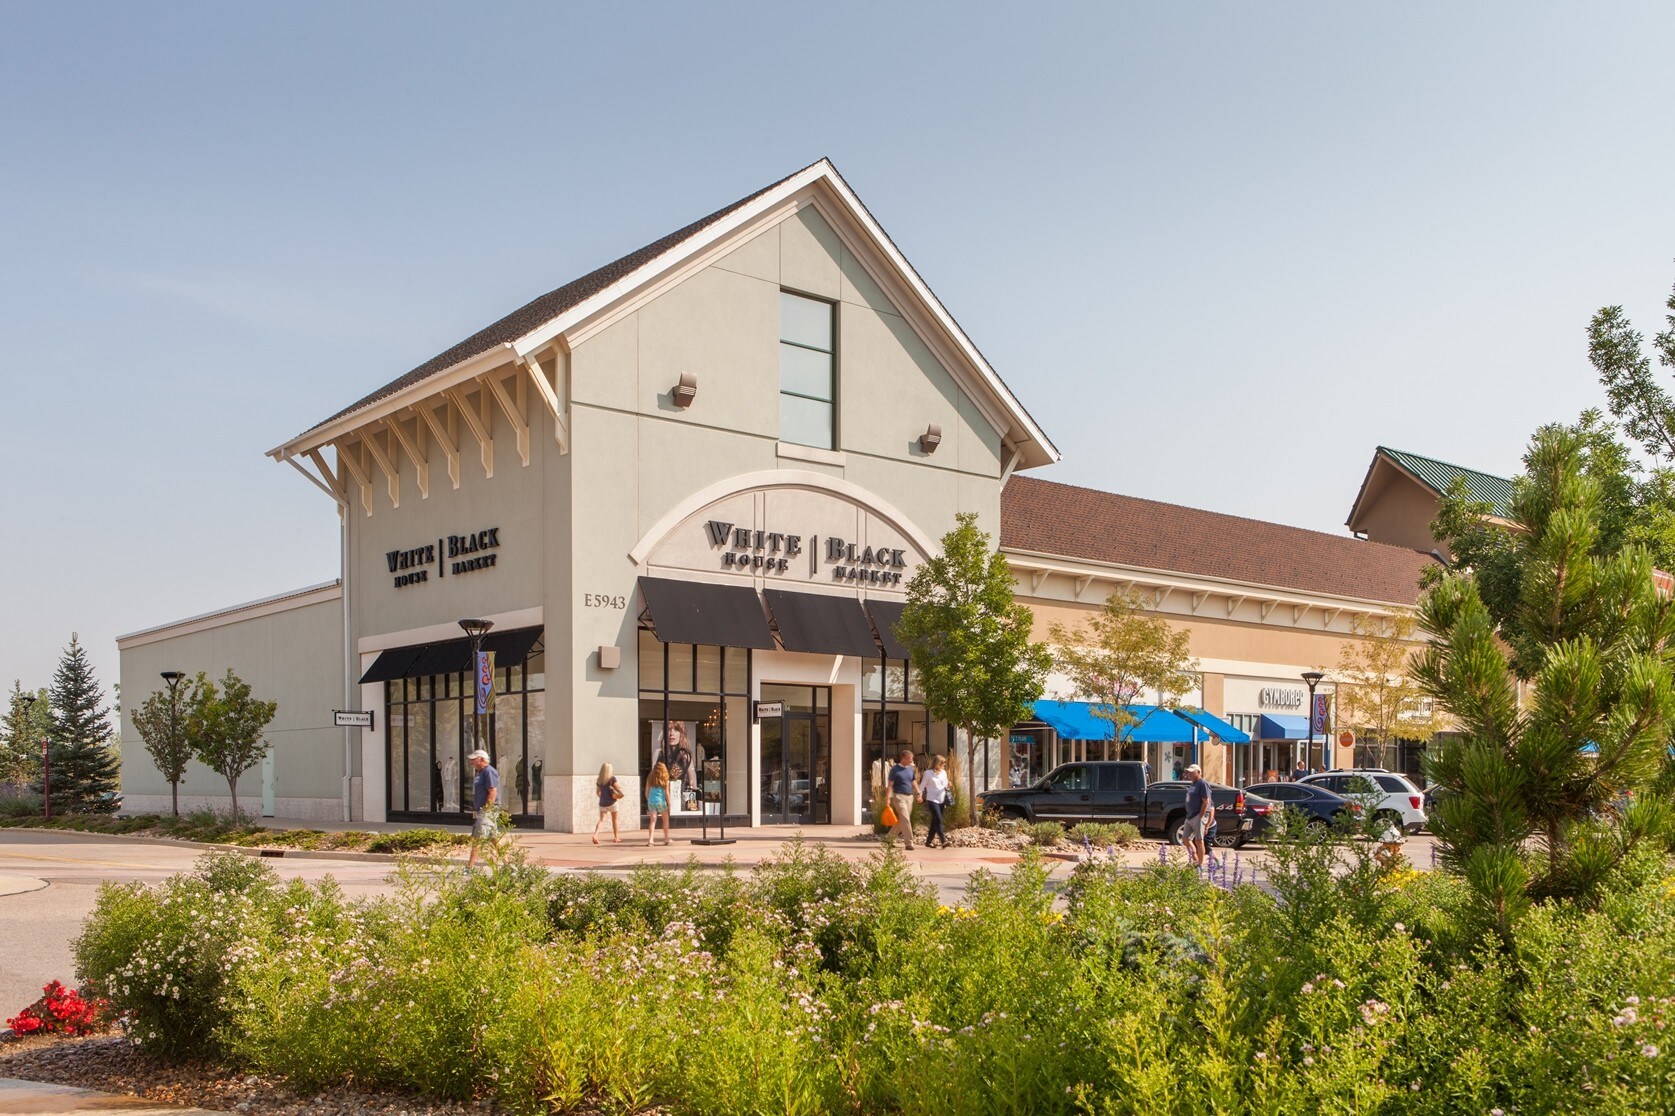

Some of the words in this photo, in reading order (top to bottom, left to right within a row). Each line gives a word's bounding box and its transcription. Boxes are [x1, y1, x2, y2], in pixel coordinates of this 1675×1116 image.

[386, 544, 435, 573] WHITE
[447, 527, 500, 558] BLACK
[708, 520, 802, 555] WHITE
[828, 536, 908, 568] BLACK
[393, 570, 428, 588] HOUSE
[451, 553, 497, 575] MARKET
[725, 552, 789, 571] HOUSE
[836, 565, 903, 584] MARKET
